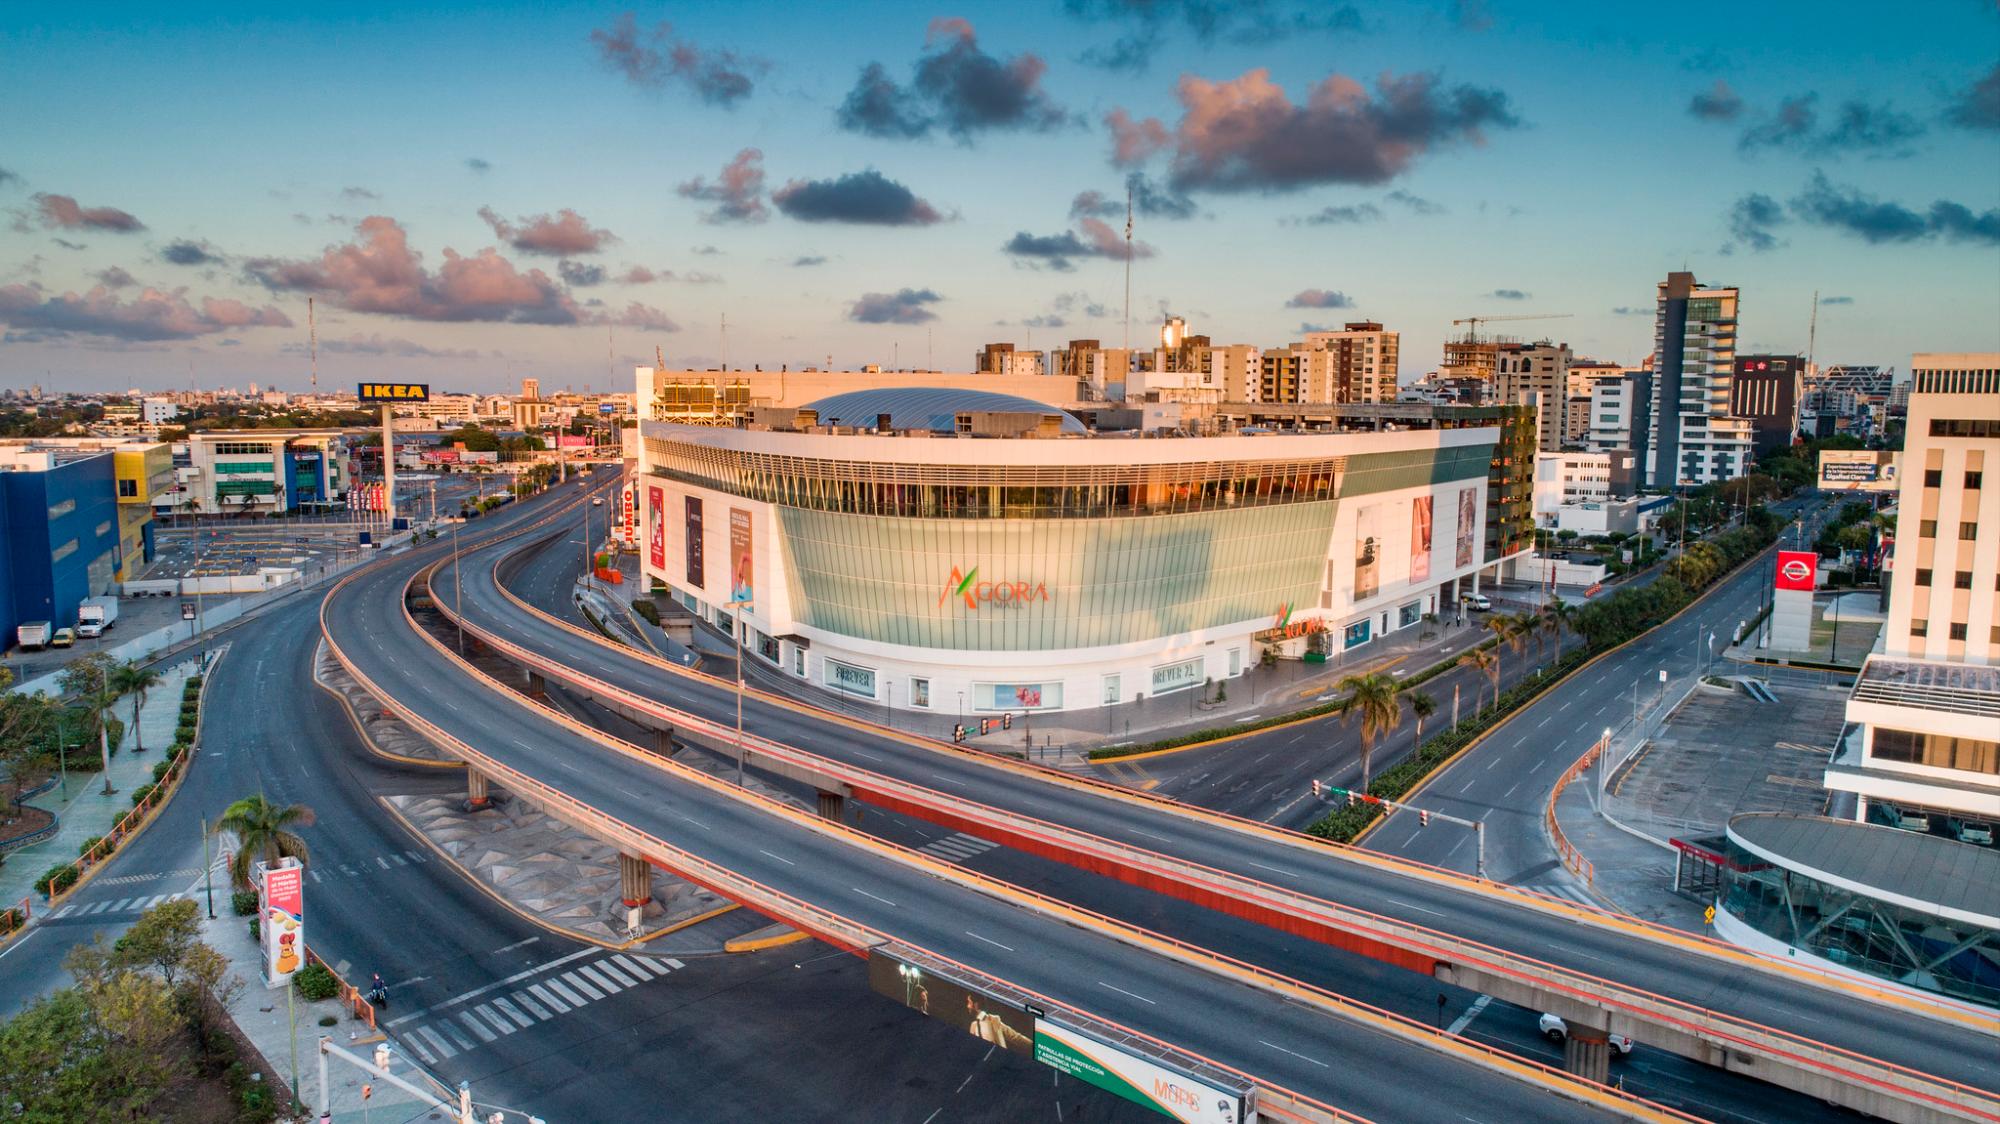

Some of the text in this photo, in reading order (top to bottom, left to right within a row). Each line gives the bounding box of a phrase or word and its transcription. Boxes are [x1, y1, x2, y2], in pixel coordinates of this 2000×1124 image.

[364, 385, 425, 397] IKEA
[625, 491, 633, 544] JUMBO
[836, 665, 869, 687] FOREVER
[1037, 1043, 1065, 1059] PATRULLAS
[1070, 1064, 1082, 1073] VIAL
